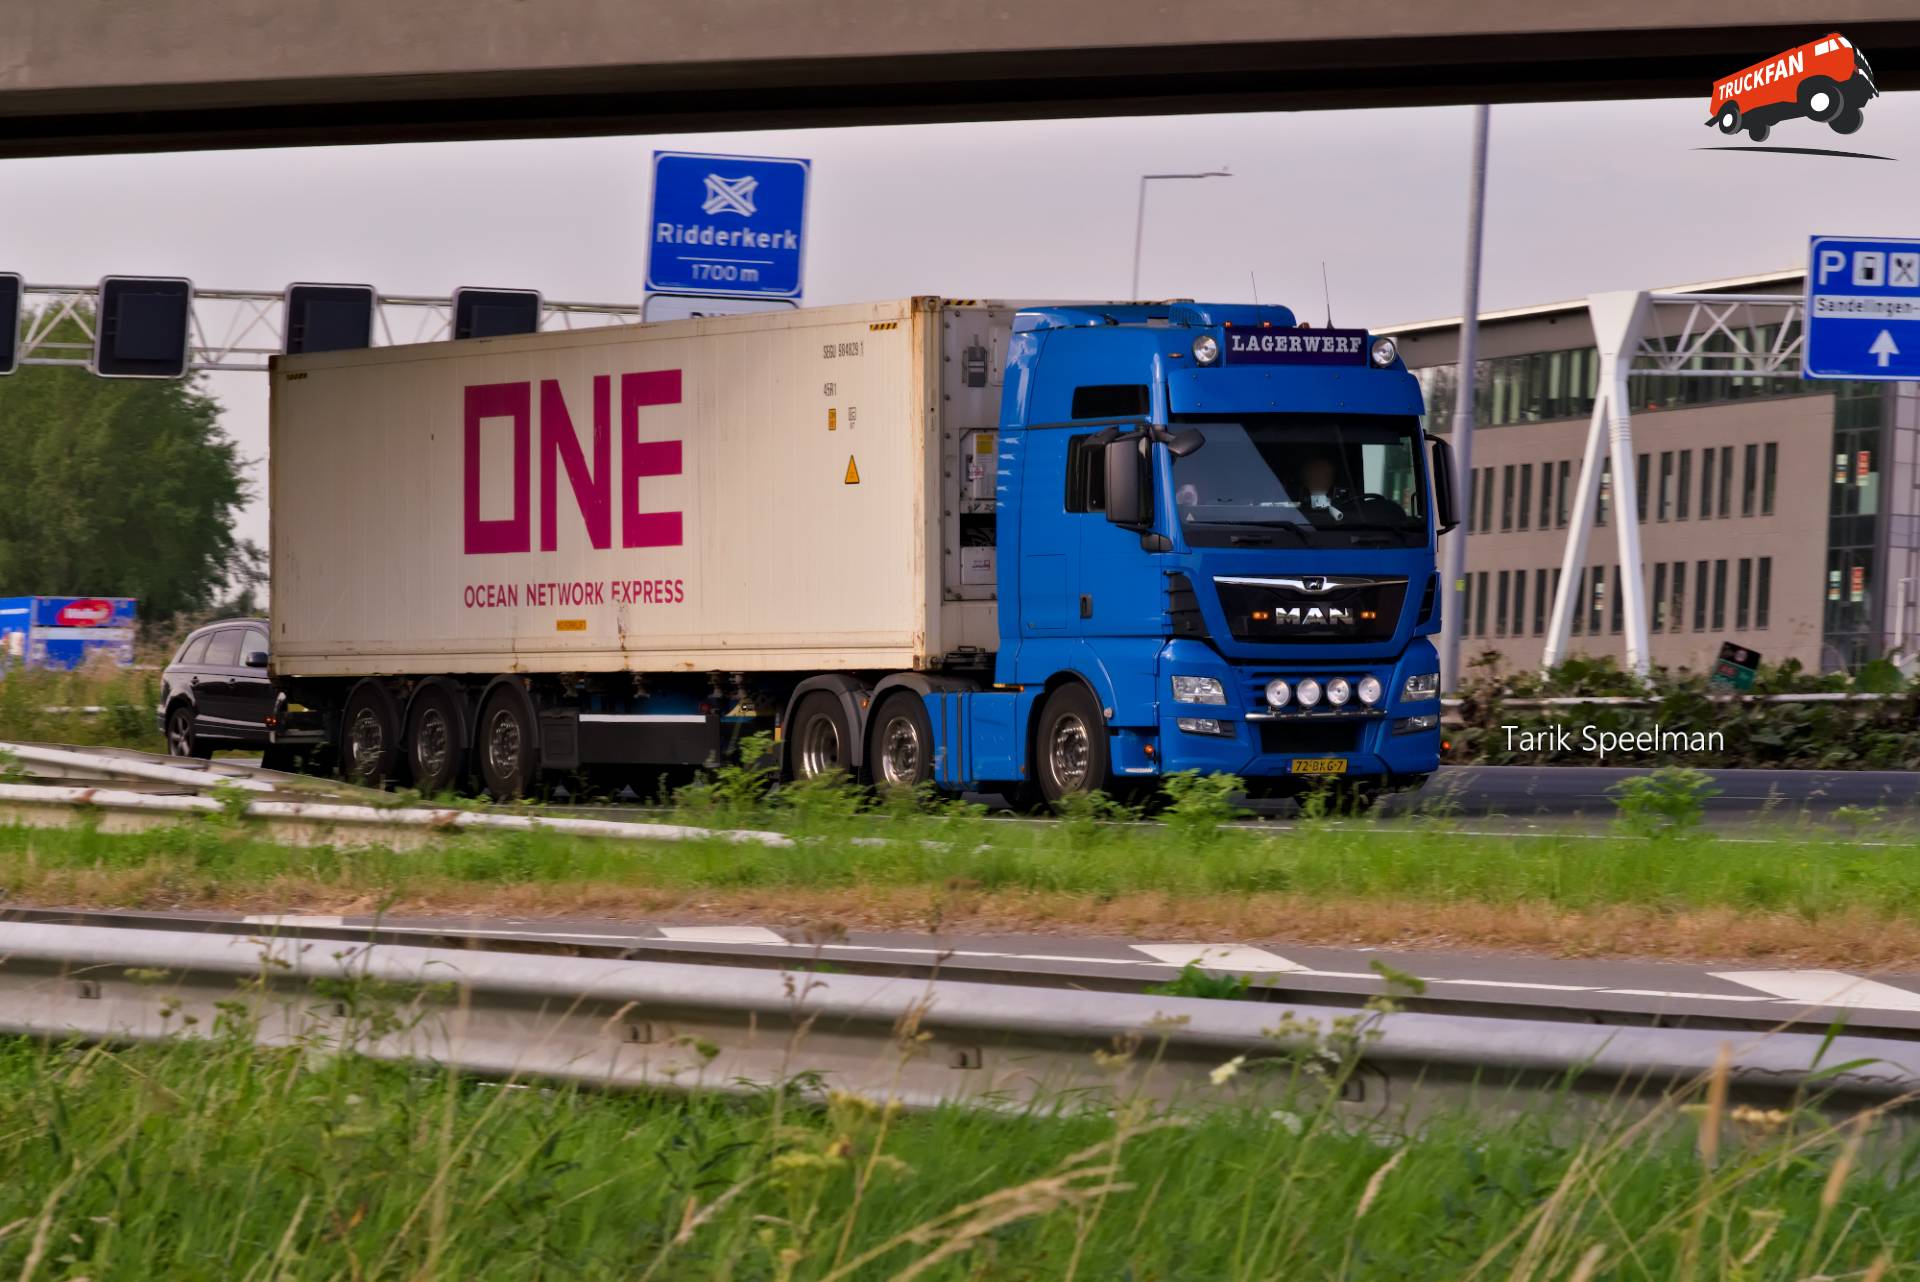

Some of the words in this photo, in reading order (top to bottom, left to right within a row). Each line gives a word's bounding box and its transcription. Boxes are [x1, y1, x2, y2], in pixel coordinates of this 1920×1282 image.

[656, 222, 798, 250] Ridderkerk
[1818, 250, 1847, 286] P
[1232, 335, 1362, 353] LAGERWERF
[464, 369, 683, 555] ONE
[464, 585, 518, 608] OCEAN
[526, 582, 604, 607] NETWORK
[611, 579, 684, 604] EXPRESS
[1275, 607, 1354, 625] MAN
